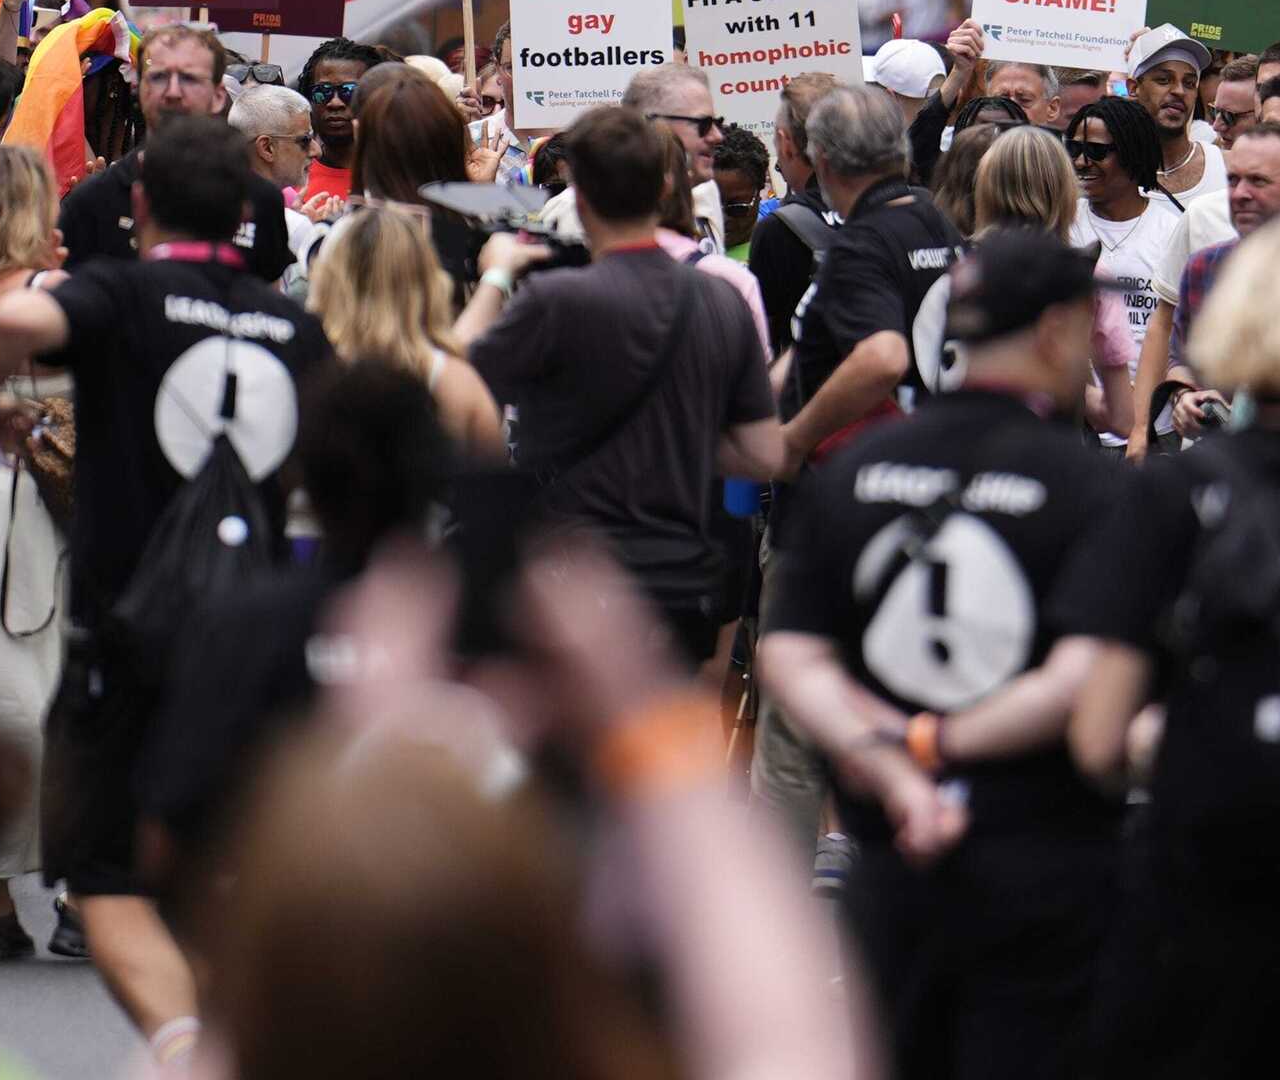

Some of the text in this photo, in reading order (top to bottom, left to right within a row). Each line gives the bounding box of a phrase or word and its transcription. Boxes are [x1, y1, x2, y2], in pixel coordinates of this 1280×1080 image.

[568, 11, 615, 35] gay
[725, 10, 817, 35] with 11
[1006, 26, 1129, 46] Peter Tatchell Foundation
[520, 46, 664, 68] footballers
[698, 39, 852, 67] homophobic
[548, 90, 572, 99] Peter
[575, 90, 610, 99] Tatchell
